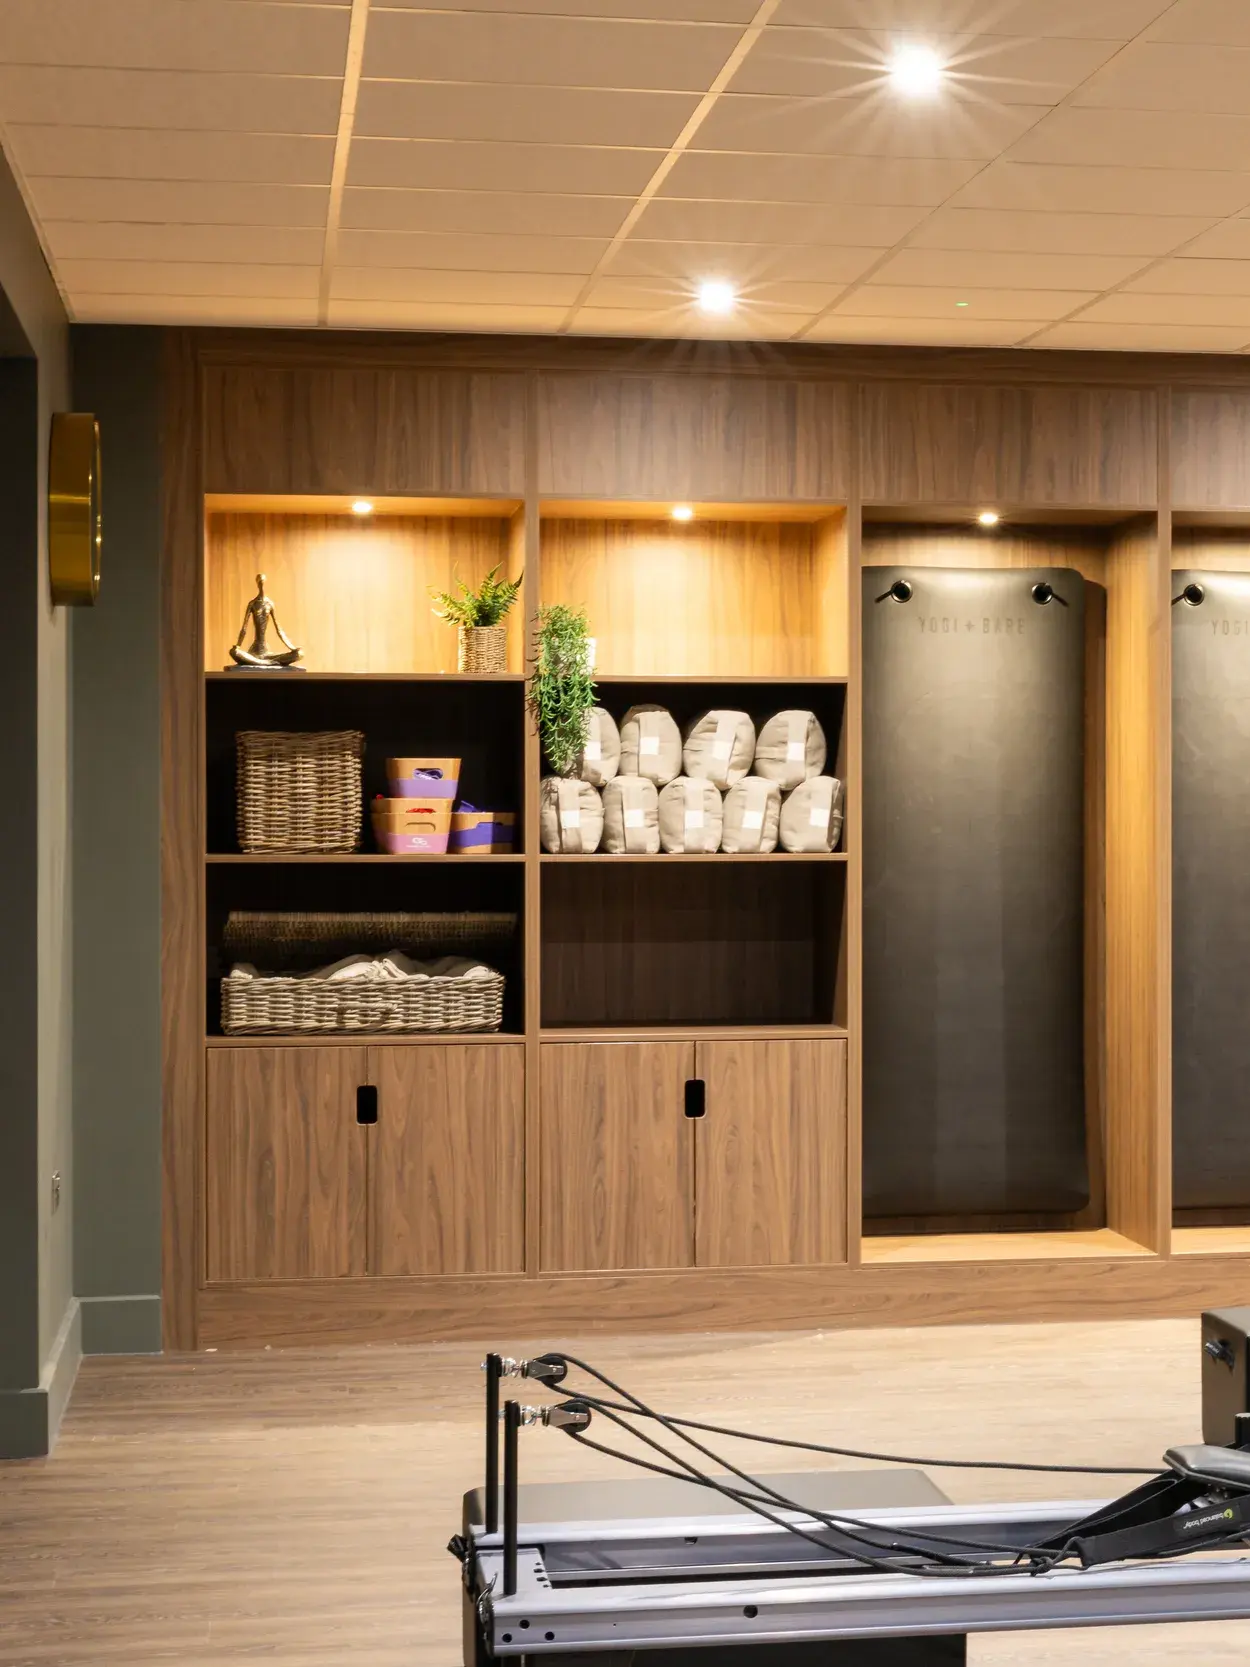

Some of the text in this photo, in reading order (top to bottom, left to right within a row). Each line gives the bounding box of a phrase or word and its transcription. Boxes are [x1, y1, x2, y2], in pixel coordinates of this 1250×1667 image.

[918, 616, 958, 633] YOGI
[982, 618, 1026, 635] BARE
[1211, 619, 1249, 636] YOGI
